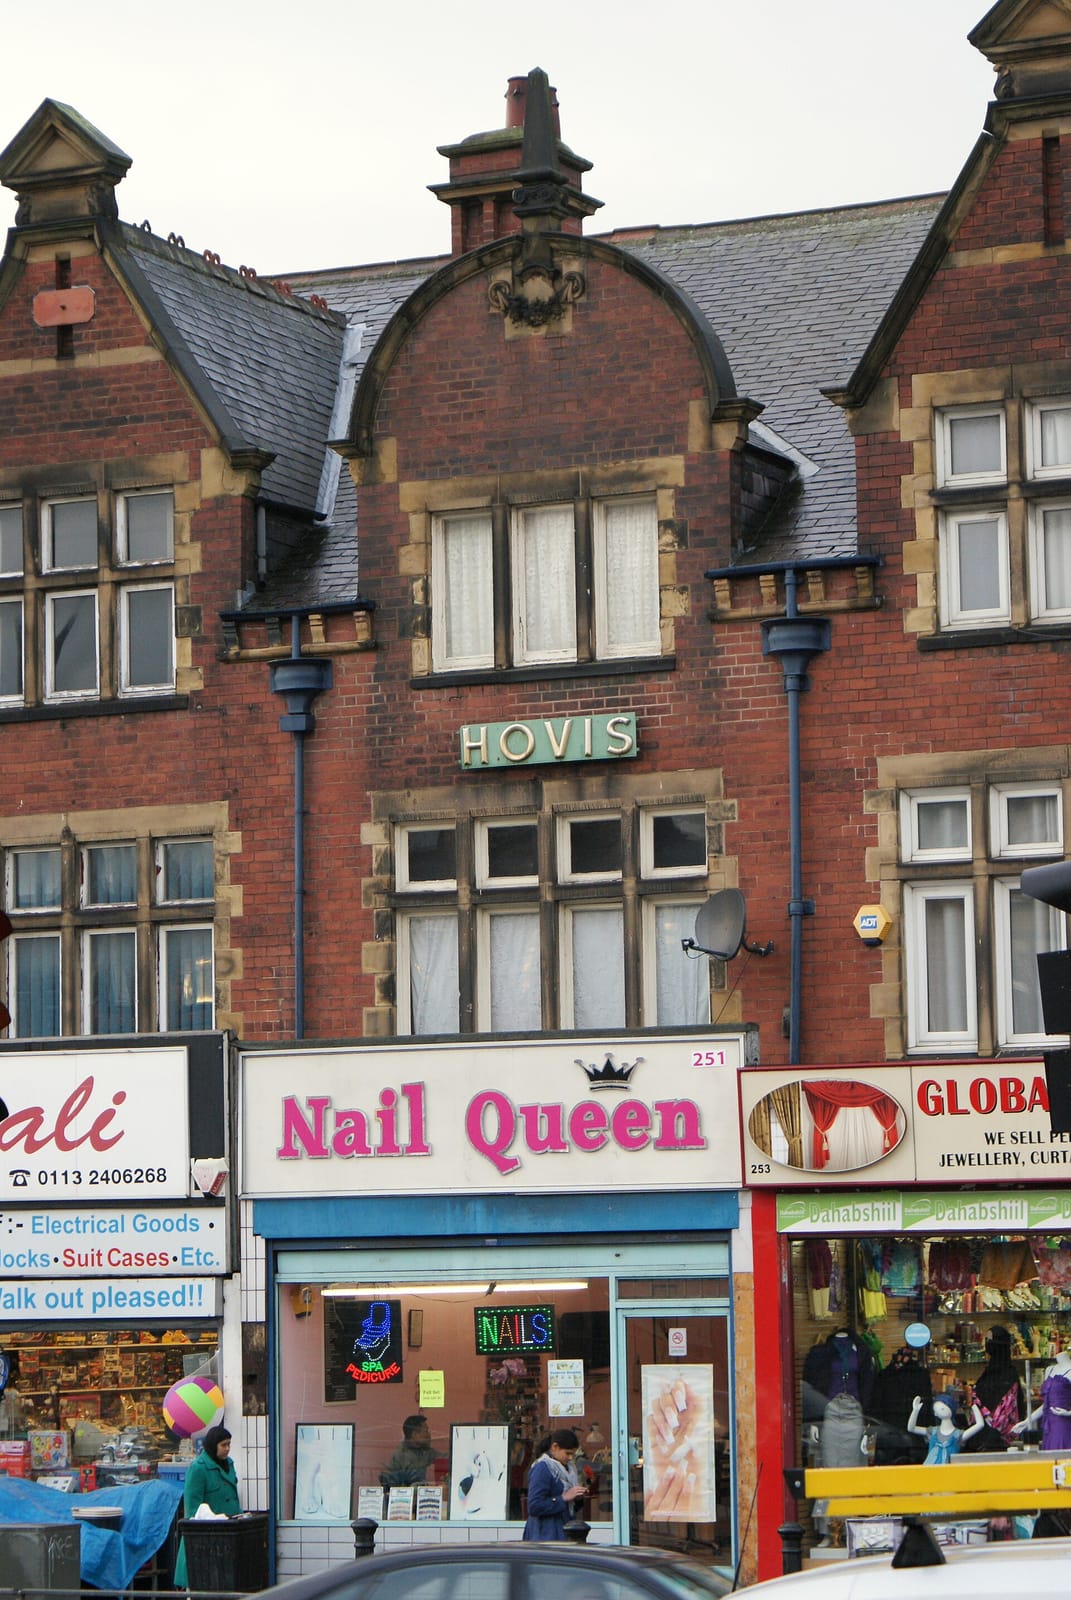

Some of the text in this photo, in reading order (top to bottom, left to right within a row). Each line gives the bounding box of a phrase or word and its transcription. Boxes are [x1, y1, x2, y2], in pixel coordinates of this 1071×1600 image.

[462, 716, 633, 766] HOVIS
[860, 916, 878, 928] ADT
[692, 1051, 726, 1067] 251
[917, 1076, 1051, 1116] GLOBA
[276, 1081, 708, 1175] Nail Queen
[984, 1130, 1071, 1145] WE SELL PE
[751, 1163, 771, 1174] 253
[939, 1150, 1071, 1168] JEWELLERY, CURT
[38, 1167, 168, 1186] 0113 2406268
[808, 1200, 897, 1223] Dahabshiil
[935, 1199, 1024, 1221] Dahabshiil
[31, 1214, 125, 1234] Electrical
[132, 1213, 200, 1234] Goods
[0, 1246, 220, 1268] ocks Suit Cases Etc.
[0, 1284, 204, 1314] alk out pleased!!
[482, 1313, 549, 1345] NAILS
[344, 1361, 401, 1384] PEDICURE
[361, 1360, 384, 1372] SPA
